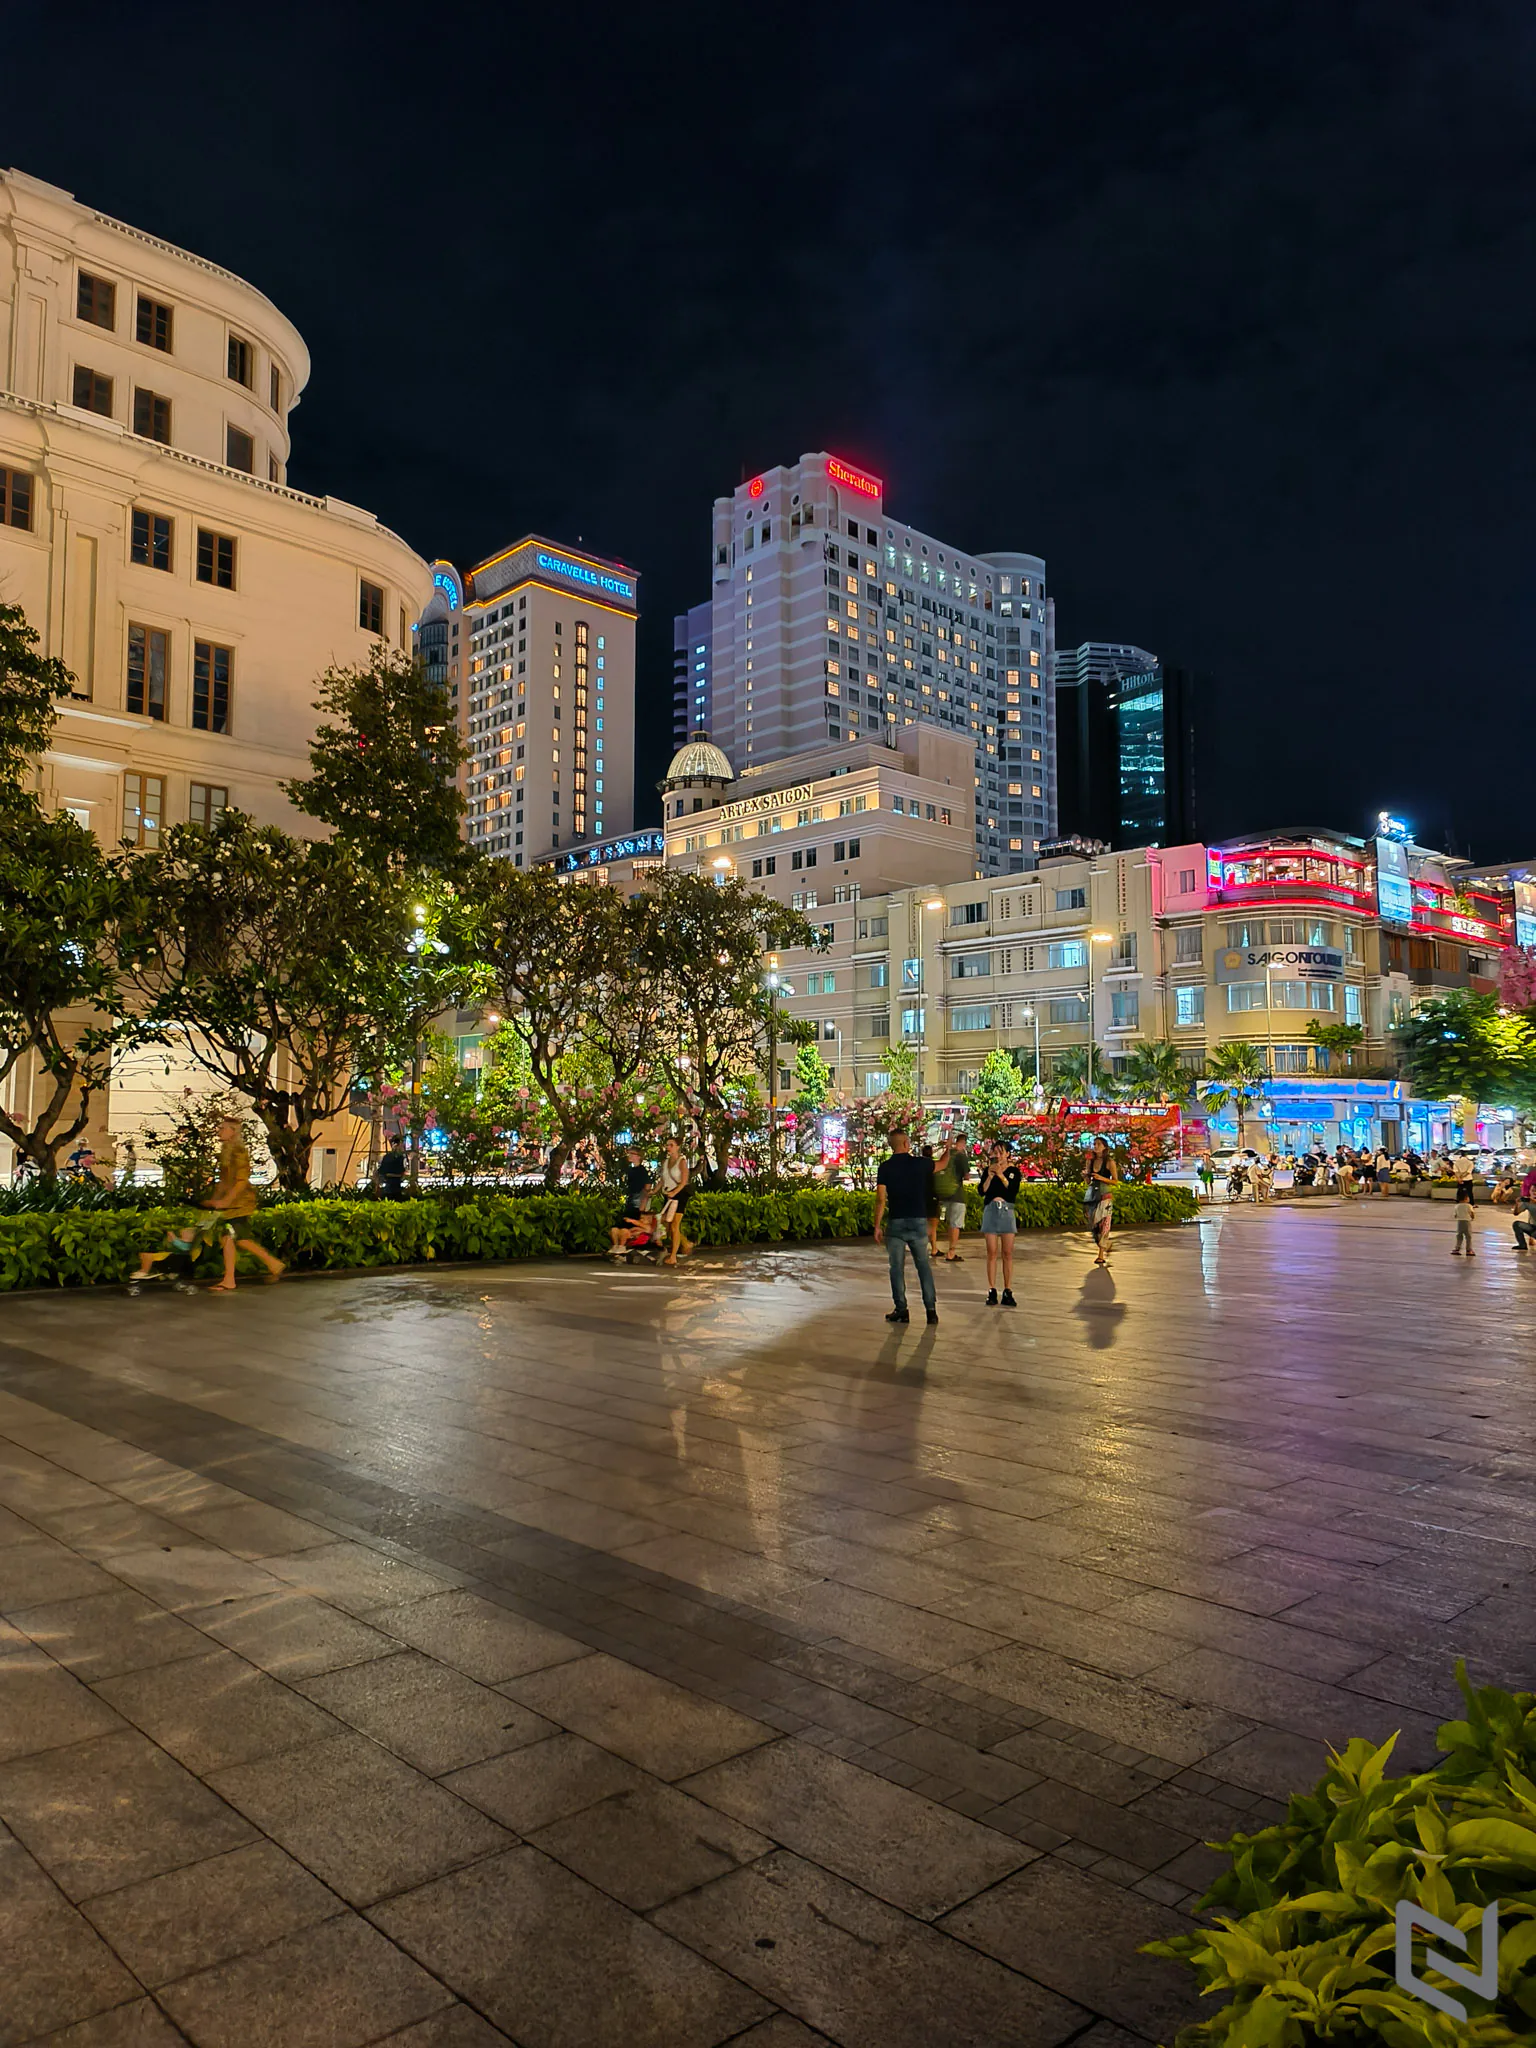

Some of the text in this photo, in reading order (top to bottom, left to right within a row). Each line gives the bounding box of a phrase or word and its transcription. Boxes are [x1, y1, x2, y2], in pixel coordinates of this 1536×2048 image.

[828, 460, 878, 497] Sheraton
[537, 554, 633, 598] CARAVELLE HOTEL
[1121, 672, 1155, 692] Hilton
[719, 784, 814, 821] ARTEX SAIGON
[1247, 951, 1343, 967] SAIGONTOU
